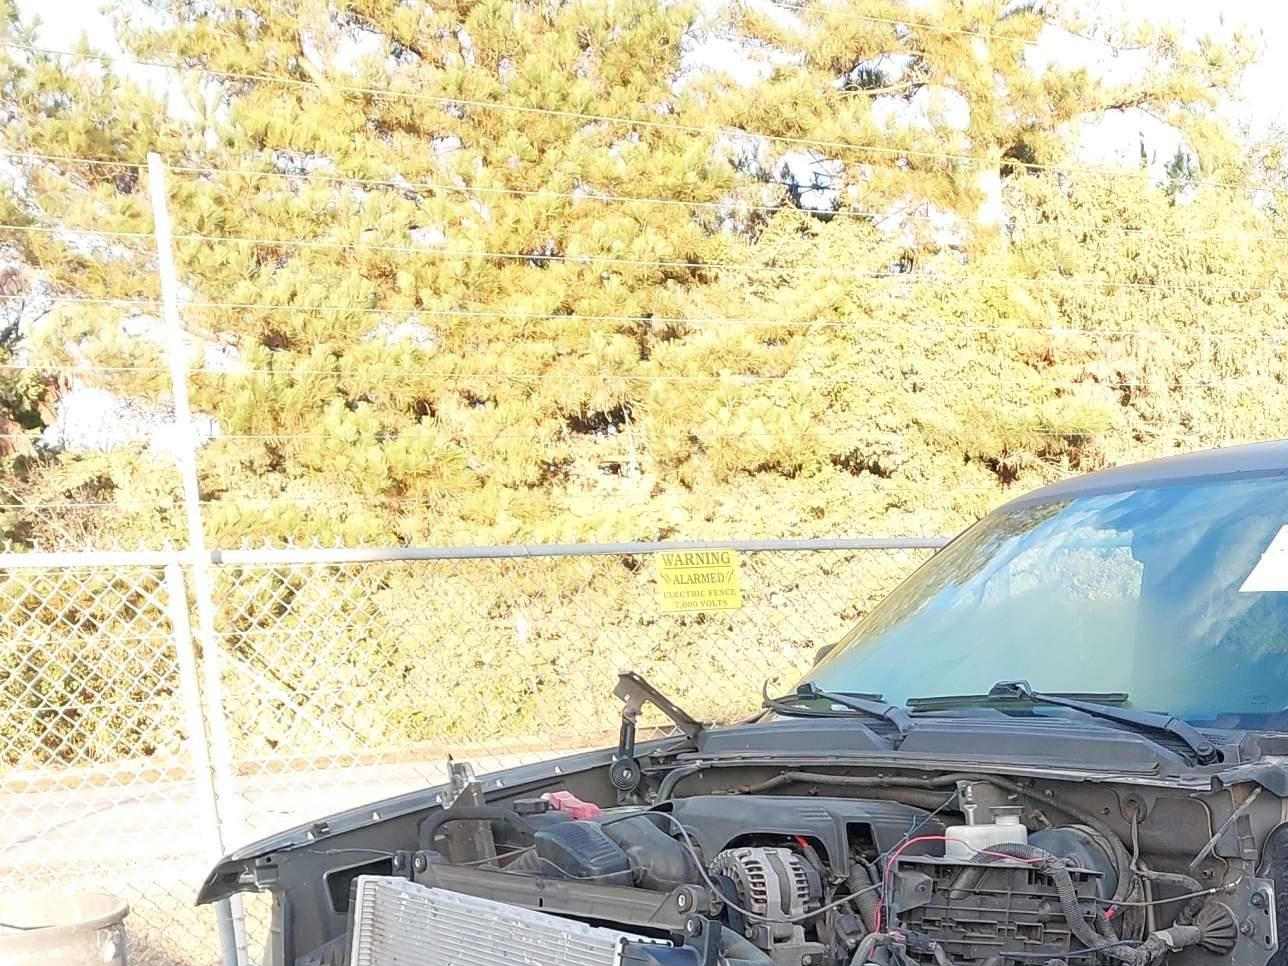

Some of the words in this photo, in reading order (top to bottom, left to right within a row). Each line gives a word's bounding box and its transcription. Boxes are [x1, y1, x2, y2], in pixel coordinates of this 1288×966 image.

[661, 551, 731, 567] WARNING
[673, 572, 725, 585] ALARMED
[663, 589, 706, 599] ELECTRIC
[708, 588, 737, 597] FENCE
[700, 599, 728, 607] VOLTS
